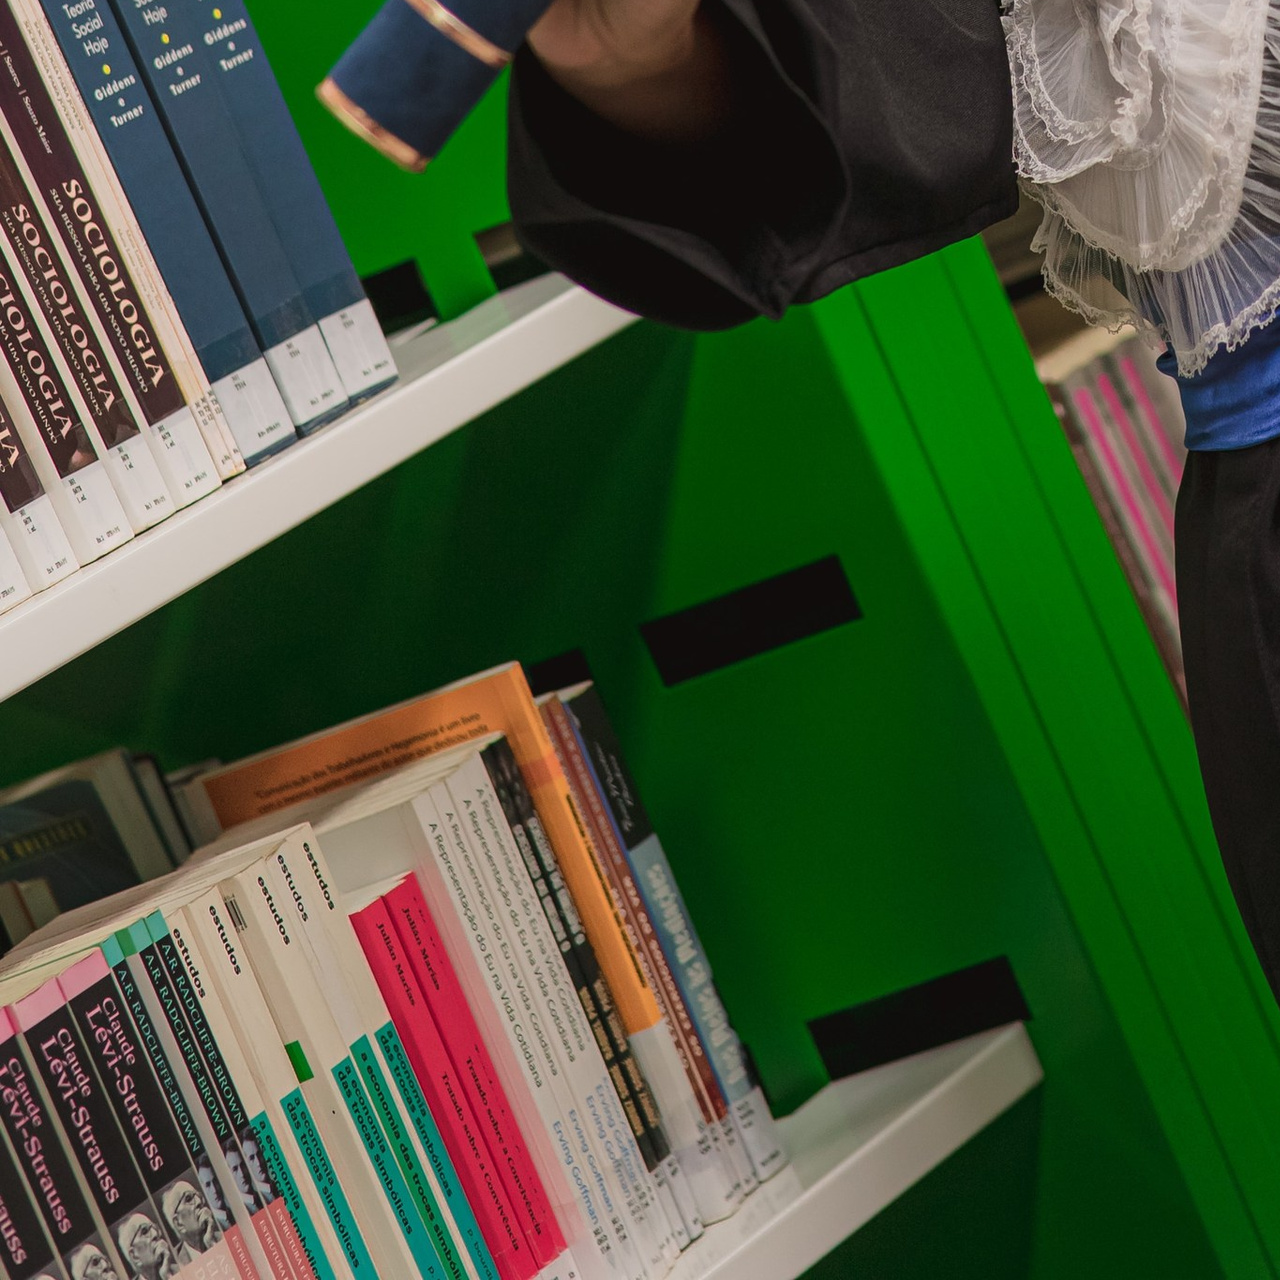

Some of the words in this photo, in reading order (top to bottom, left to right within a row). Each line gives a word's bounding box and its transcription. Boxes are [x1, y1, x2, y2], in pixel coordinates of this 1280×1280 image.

[72, 12, 104, 39] Social
[83, 37, 109, 57] Hoje
[142, 6, 167, 26] Hoje
[154, 44, 193, 70] Giddens
[203, 18, 246, 45] Giddens
[94, 74, 135, 101] Giddens
[169, 74, 201, 96] Turner
[220, 49, 254, 71] Turner
[4, 55, 22, 87] Soares
[22, 95, 39, 125] Souto
[35, 125, 53, 155] Maior
[111, 104, 144, 127] Turner
[2, 210, 15, 233] SUA
[38, 285, 53, 314] PARA
[51, 315, 63, 336] UM
[62, 337, 80, 370] NOVO
[78, 371, 102, 416] MUNDO
[12, 201, 117, 411] SOCIOLOGIA
[50, 187, 64, 212] SUA
[85, 262, 101, 291] PARA
[98, 292, 111, 313] UM
[108, 313, 127, 347] NOVO
[124, 348, 148, 393] MUNDO
[62, 176, 167, 388] SOCIOLOGIA
[7, 342, 19, 362] UM
[17, 364, 35, 397] NOVO
[34, 399, 57, 444] MUNDO
[444, 810, 455, 823] A
[257, 875, 291, 945] estudos
[276, 853, 310, 922] estudos
[302, 841, 335, 910] estudos
[449, 823, 495, 921] Representação
[172, 927, 207, 998] estudos
[208, 904, 243, 975] estudos
[376, 921, 398, 961] Julián
[394, 962, 417, 1007] Marías
[401, 906, 423, 946] Julián
[419, 947, 442, 991] Marías
[427, 821, 438, 834] A
[433, 834, 480, 932] Representação
[474, 932, 488, 952] do
[483, 953, 496, 971] Eu
[491, 972, 504, 991] na
[498, 990, 517, 1022] Vida
[512, 1022, 545, 1088] Cotidiana
[461, 797, 473, 810] A
[467, 809, 513, 907] Representação
[508, 908, 522, 928] do
[516, 928, 530, 947] Eu
[524, 947, 538, 967] na
[532, 966, 551, 998] Vida
[545, 997, 578, 1062] Cotidiana
[490, 921, 504, 941] do
[499, 941, 512, 960] Eu
[507, 961, 520, 980] na
[101, 995, 138, 1065] Claude
[514, 979, 533, 1011] Vida
[56, 1026, 94, 1097] Claude
[131, 1001, 200, 1151] RADCLIFFE-BROWN
[158, 986, 227, 1136] RADCLIFFE-BROWN
[175, 975, 244, 1125] RADCLIFFE-BROWN
[385, 1029, 395, 1039] a
[393, 1043, 428, 1117] economia
[527, 1011, 560, 1076] Cotidiana
[6, 1056, 44, 1127] Claude
[39, 1035, 122, 1204] Lévi-Strauss
[84, 1003, 166, 1171] Lévi-Strauss
[343, 1065, 352, 1075] a
[350, 1079, 387, 1153] economia
[379, 1033, 395, 1062] das
[392, 1064, 418, 1113] trocas
[415, 1115, 454, 1197] simbólicas
[258, 1119, 267, 1128] a
[265, 1134, 301, 1210] economia
[292, 1096, 301, 1106] a
[299, 1110, 335, 1186] economia
[336, 1069, 353, 1098] das
[350, 1100, 376, 1150] trocas
[373, 1152, 413, 1235] simbólicas
[359, 1051, 369, 1061] a
[366, 1064, 401, 1140] economia
[398, 1141, 414, 1170] das
[411, 1171, 436, 1220] trocas
[432, 1222, 460, 1278] simbóli
[439, 1071, 465, 1122] Tratado
[462, 1123, 482, 1160] sobre
[477, 1160, 487, 1169] a
[482, 1170, 521, 1251] Convivência
[464, 1056, 489, 1106] Tratado
[485, 1107, 505, 1145] sobre
[500, 1145, 510, 1154] a
[506, 1155, 544, 1235] Convivência
[550, 1120, 575, 1165] Erving
[569, 1165, 601, 1225] Goffman
[565, 1108, 590, 1153] Erving
[584, 1153, 615, 1213] Goffman
[285, 1101, 301, 1130] das
[299, 1132, 323, 1181] trocas
[321, 1185, 361, 1268] simbólicas
[259, 1219, 286, 1276] ESTRUTURA
[275, 1208, 302, 1265] ESTRUTURA
